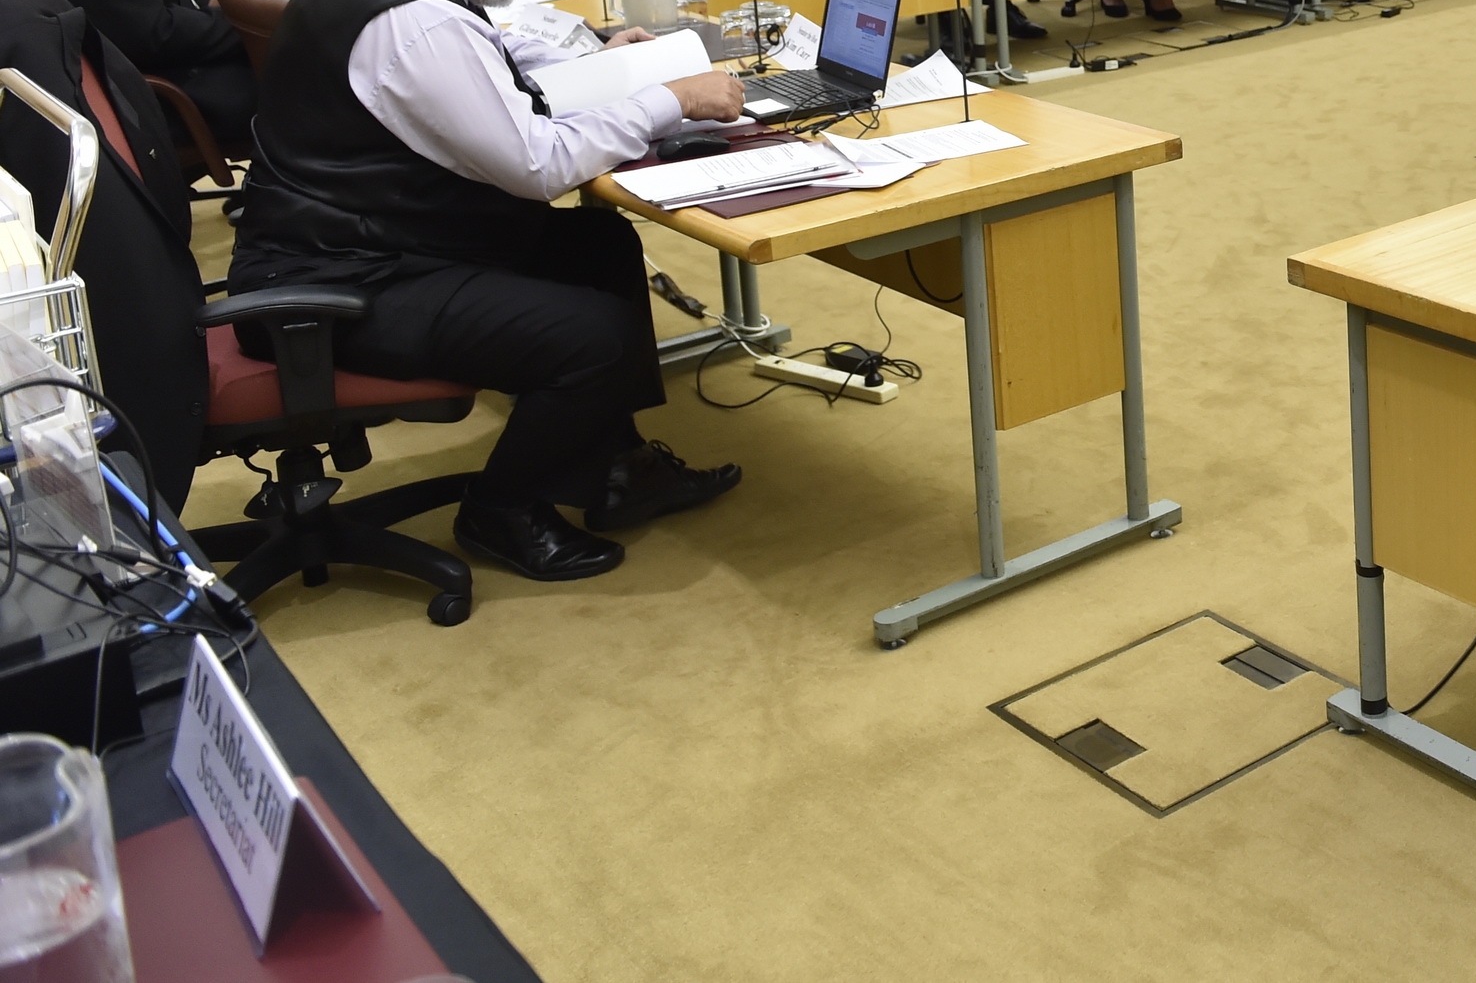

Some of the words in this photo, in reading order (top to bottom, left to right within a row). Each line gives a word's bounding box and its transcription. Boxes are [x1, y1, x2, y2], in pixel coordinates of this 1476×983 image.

[796, 46, 811, 60] Carr
[188, 661, 211, 727] Ms
[210, 700, 255, 802] Ashlee
[253, 770, 286, 854] Hill
[196, 742, 256, 876] Secretariat
